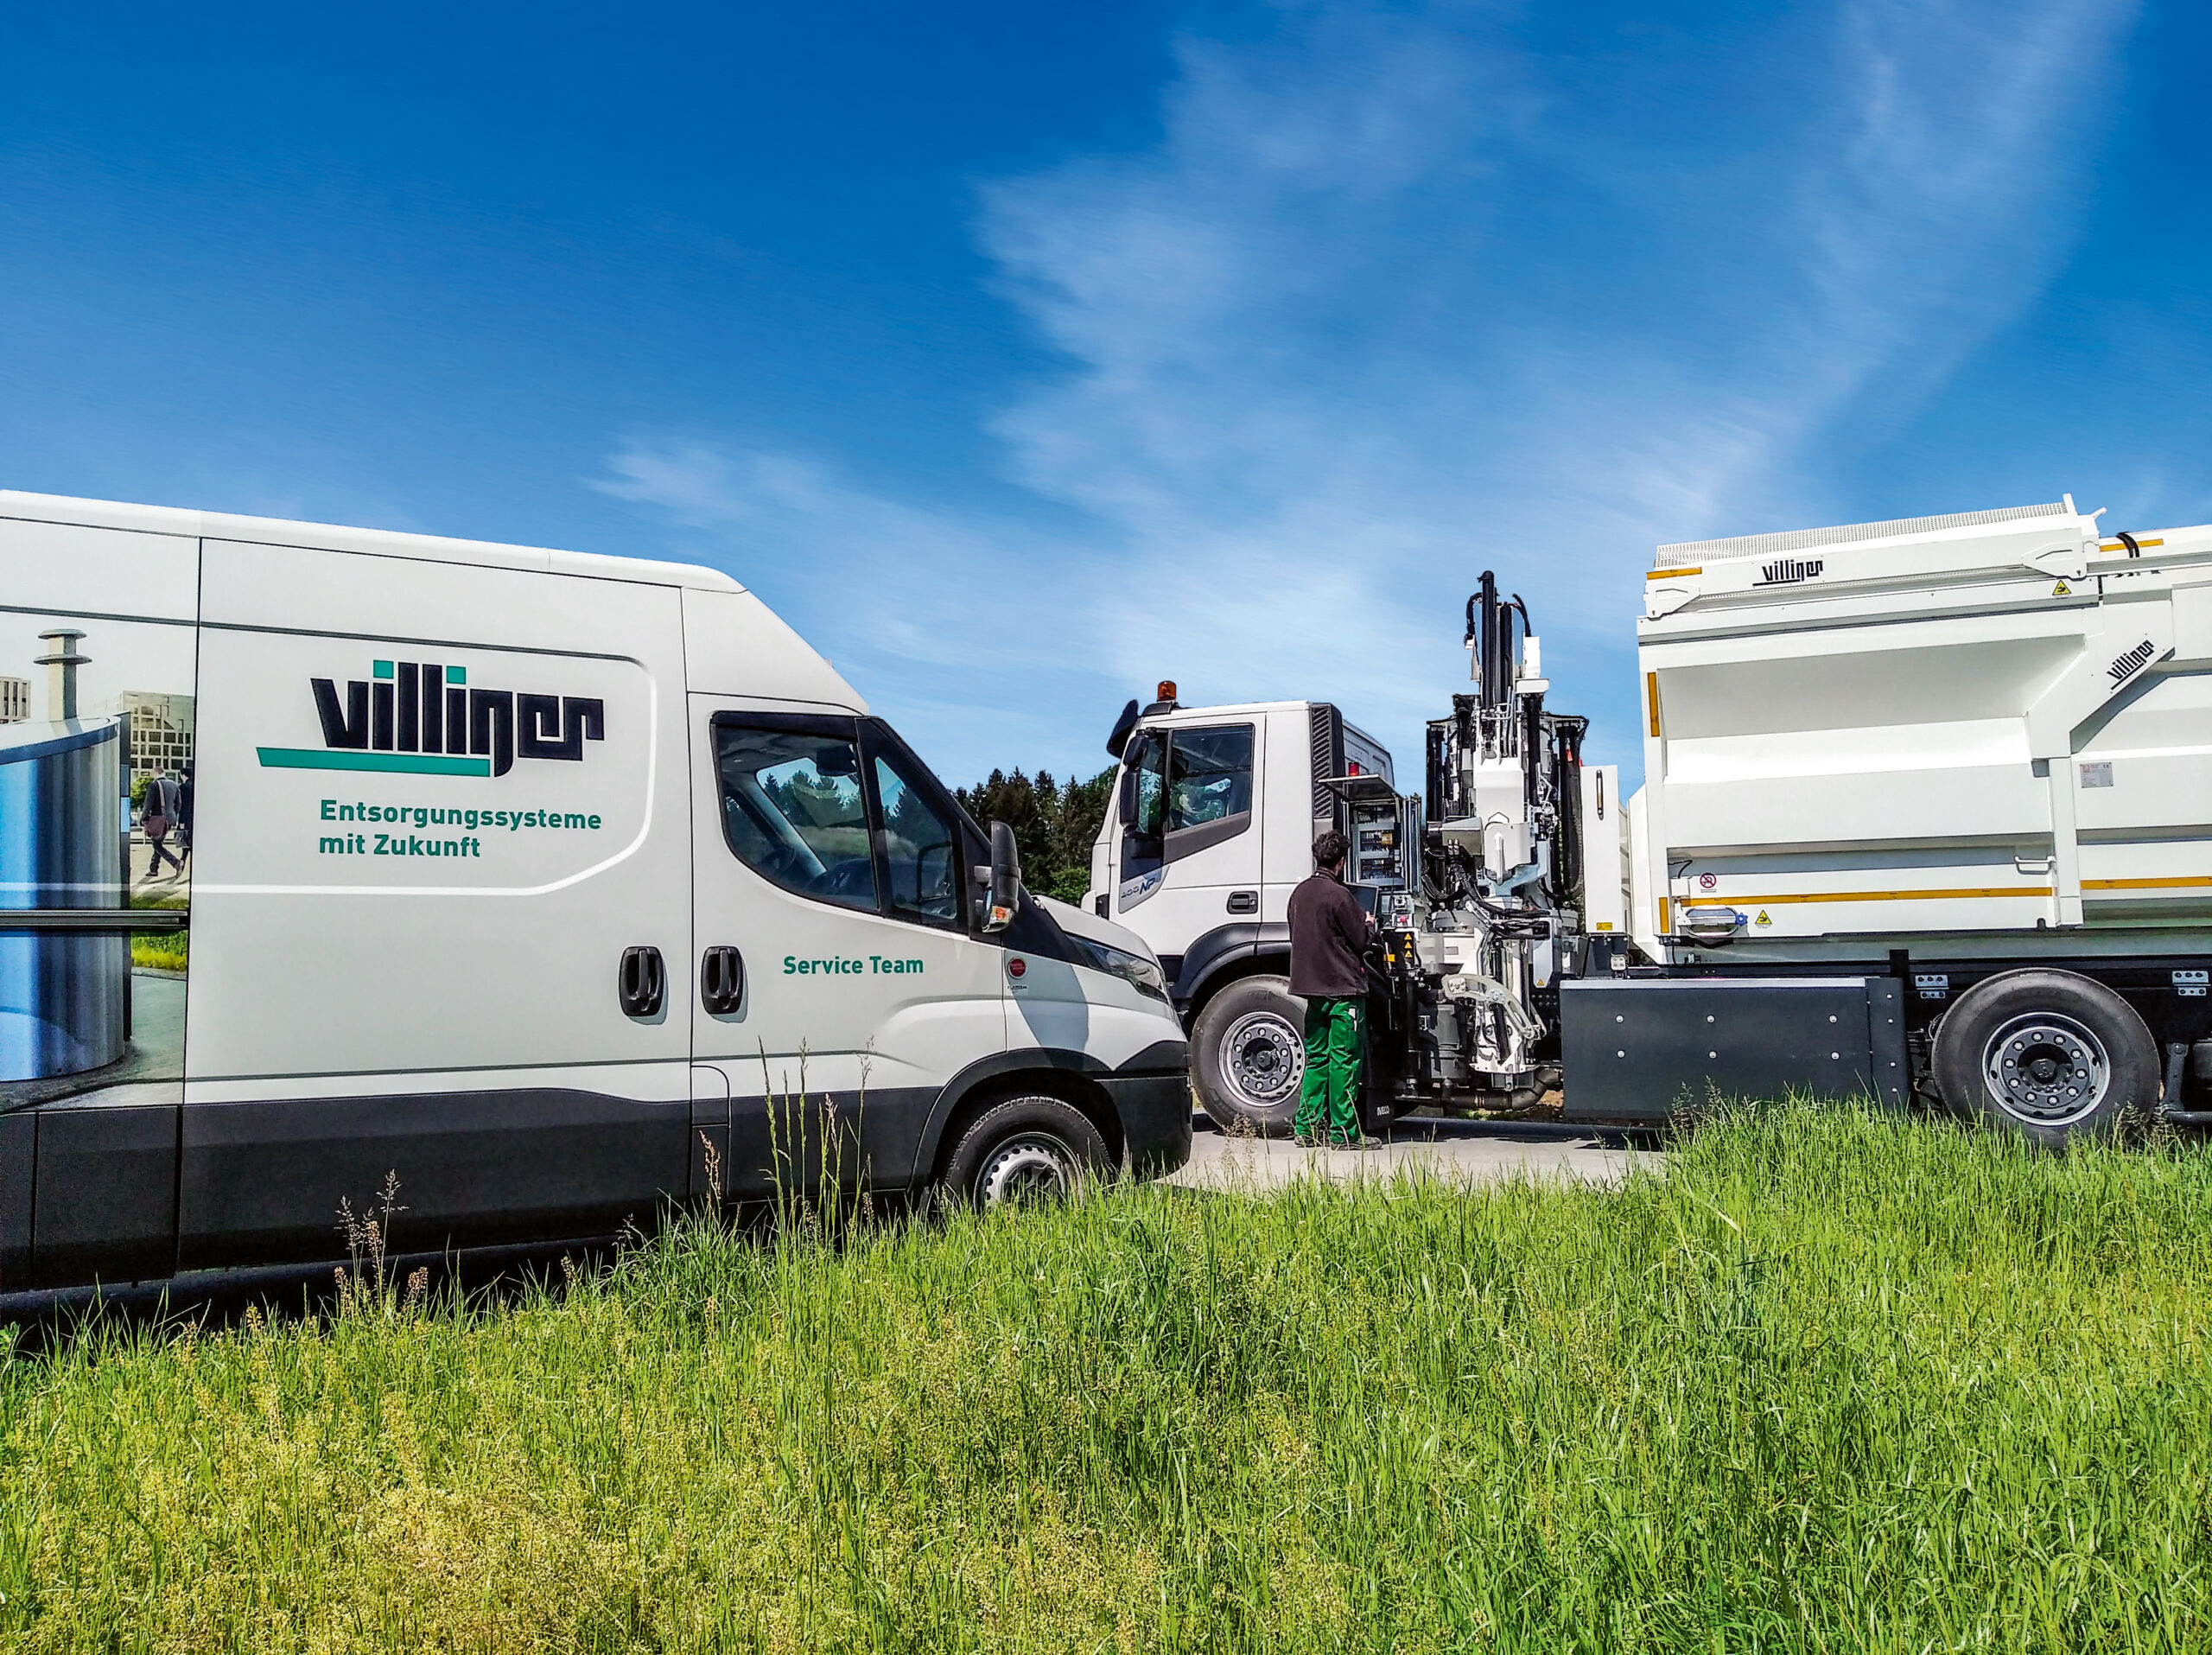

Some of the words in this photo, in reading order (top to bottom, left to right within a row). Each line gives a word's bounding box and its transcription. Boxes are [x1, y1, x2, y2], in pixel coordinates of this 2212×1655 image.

[1762, 558, 1823, 582] villiger
[2106, 640, 2155, 680] villiger
[310, 659, 605, 777] villiger
[320, 799, 602, 831] Entsorgungssysteme
[319, 833, 365, 854] mit
[373, 834, 480, 857] Zukunft
[783, 955, 863, 975] Service
[869, 955, 924, 974] Team
